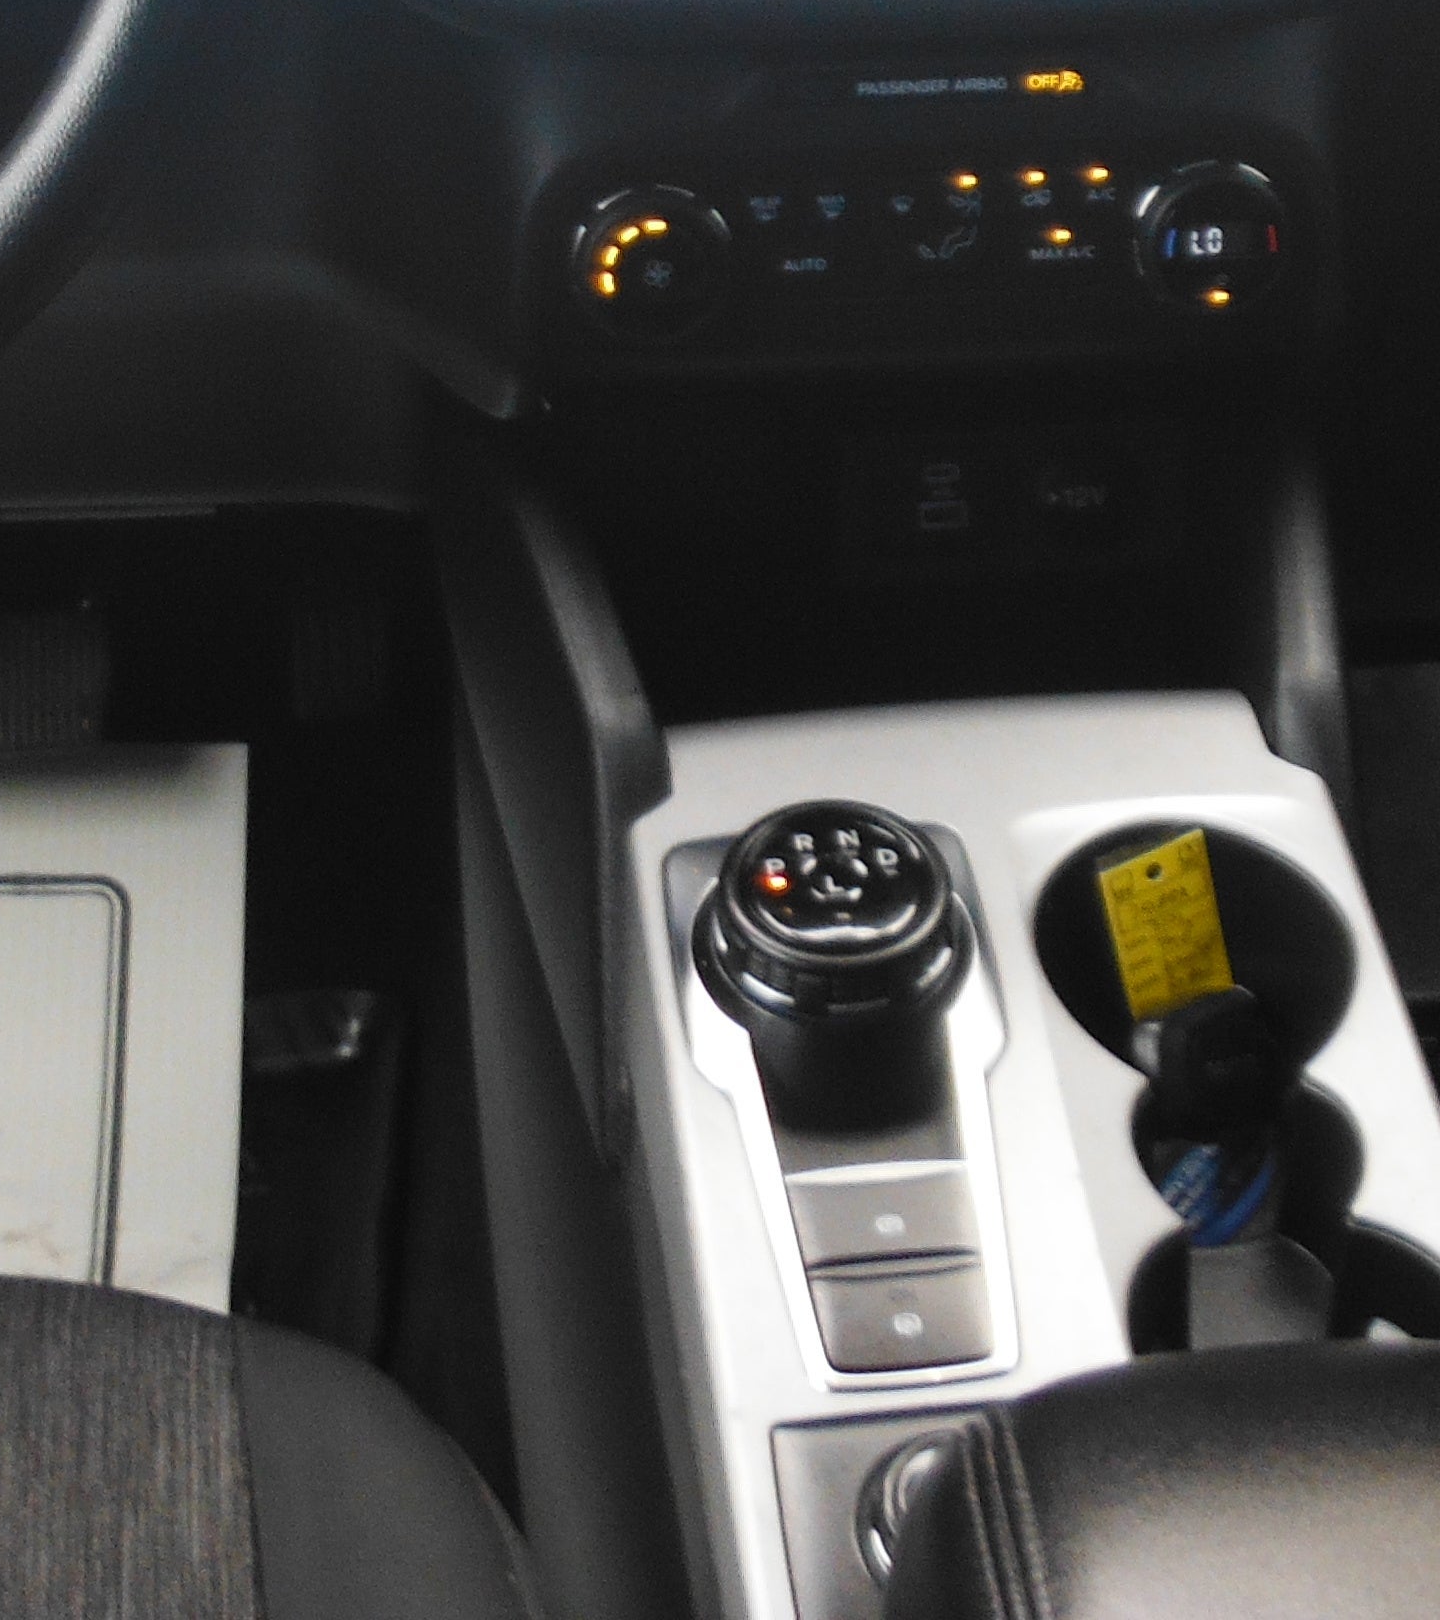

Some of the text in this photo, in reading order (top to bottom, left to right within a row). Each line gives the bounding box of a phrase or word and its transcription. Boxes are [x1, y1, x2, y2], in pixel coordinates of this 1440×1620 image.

[955, 78, 1006, 91] AIRBAG
[1027, 75, 1059, 90] OFF
[794, 833, 814, 852] R
[835, 829, 860, 849] N
[876, 847, 898, 865] D
[765, 857, 786, 875] P
